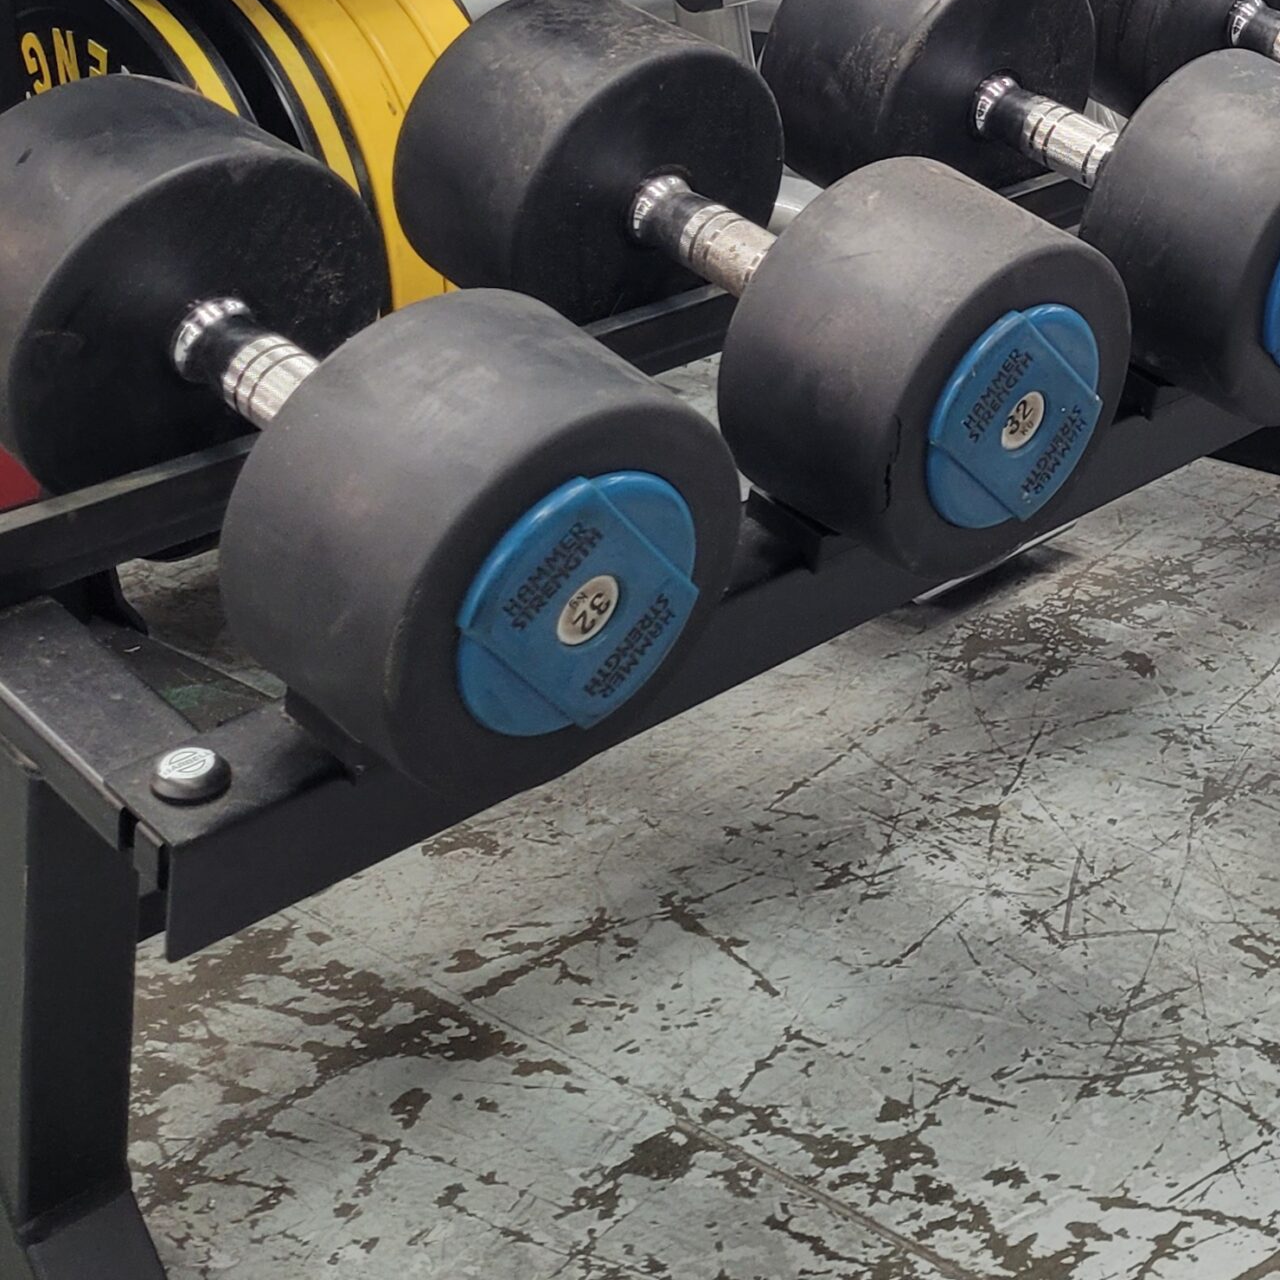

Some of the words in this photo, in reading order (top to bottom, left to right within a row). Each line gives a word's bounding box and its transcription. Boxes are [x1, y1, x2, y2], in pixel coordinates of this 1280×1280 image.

[963, 348, 1024, 430] HAMMER
[968, 351, 1034, 443] STRENGTH
[1004, 400, 1034, 435] 32
[1021, 405, 1082, 493] STRENGTH
[1033, 417, 1088, 495] HAMMER
[502, 522, 590, 617] HAMMER
[511, 527, 604, 632] STRENGTH
[571, 593, 610, 635] 32
[584, 593, 670, 698] STRENGTH
[601, 608, 677, 699] HAMMER
